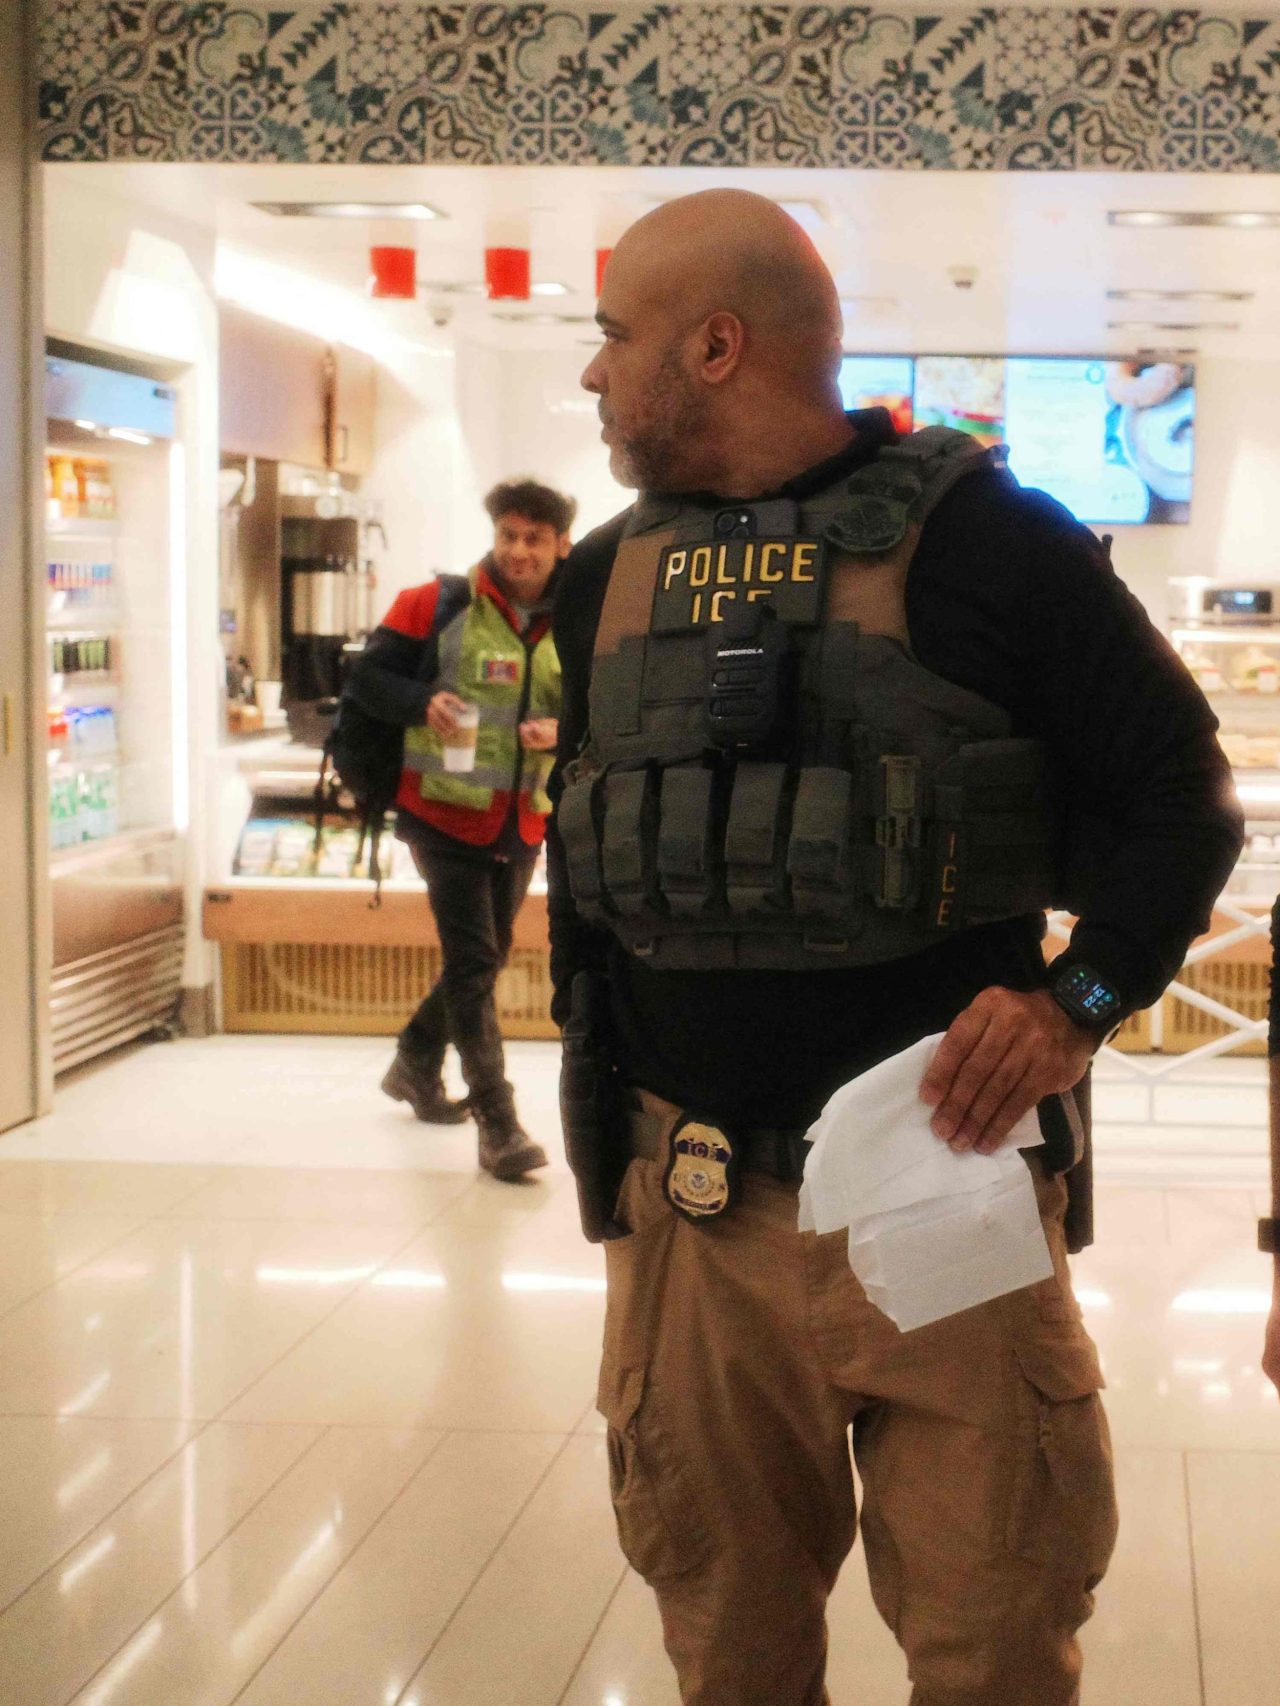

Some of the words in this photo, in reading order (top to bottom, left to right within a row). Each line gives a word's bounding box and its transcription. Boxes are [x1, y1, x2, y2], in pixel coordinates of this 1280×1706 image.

[664, 543, 818, 590] POLICE
[716, 648, 764, 657] MOTOROLA
[937, 831, 957, 926] ICE
